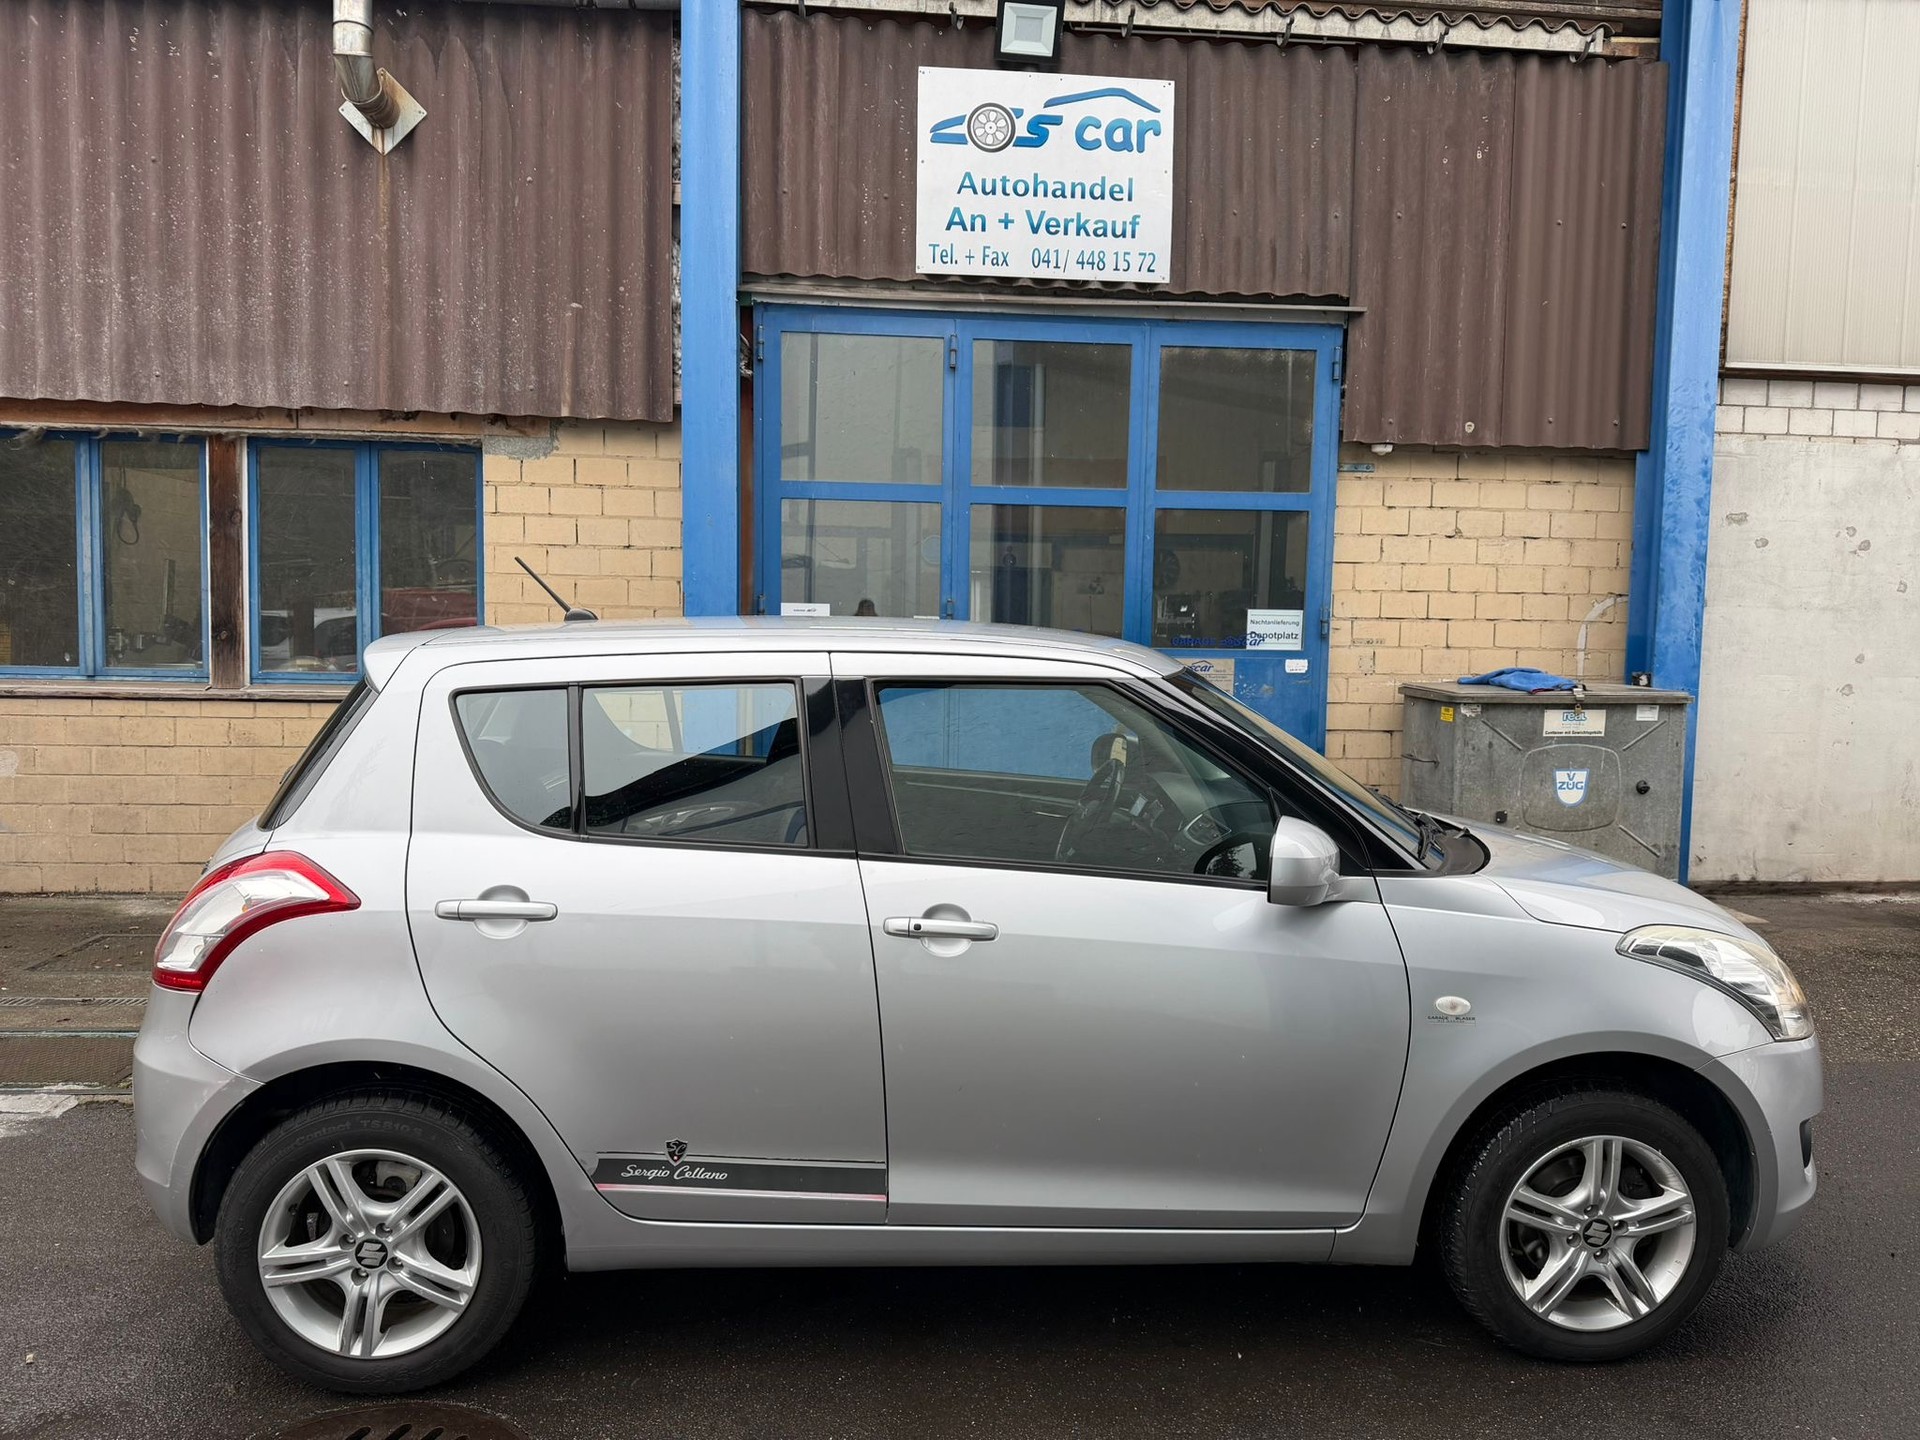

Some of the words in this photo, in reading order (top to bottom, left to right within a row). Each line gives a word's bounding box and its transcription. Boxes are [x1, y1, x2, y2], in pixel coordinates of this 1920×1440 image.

[1075, 115, 1161, 153] car
[956, 171, 1134, 202] Autohandel
[945, 207, 987, 232] An
[998, 213, 1015, 230] +
[1025, 209, 1141, 239] Verkauf
[928, 243, 958, 265] Tel.
[965, 249, 975, 265] +
[982, 246, 1010, 267] Fax
[1031, 248, 1069, 273] 041/
[1075, 249, 1106, 271] 448
[1112, 252, 1131, 272] 15
[1138, 252, 1156, 273] 72
[621, 1164, 670, 1180] Sergio
[673, 1165, 728, 1180] Cellano
